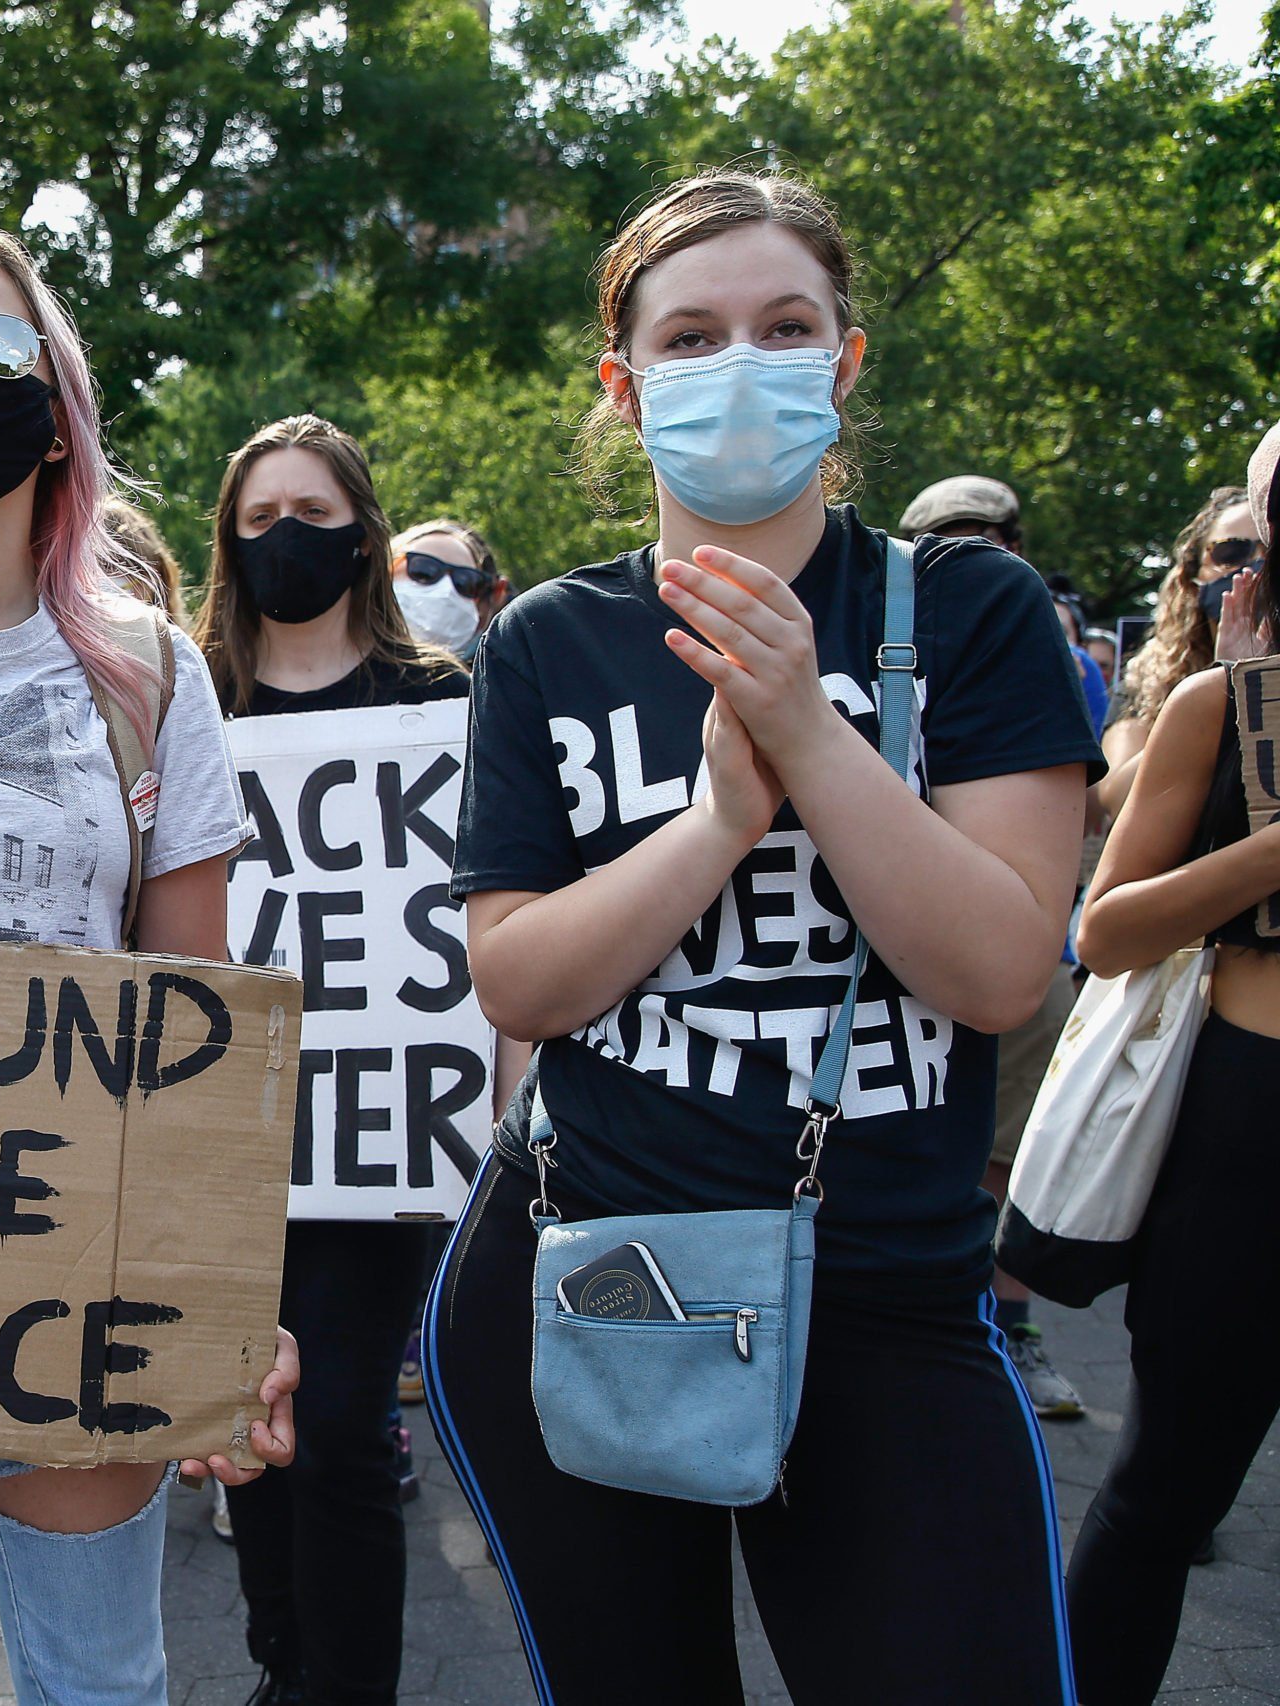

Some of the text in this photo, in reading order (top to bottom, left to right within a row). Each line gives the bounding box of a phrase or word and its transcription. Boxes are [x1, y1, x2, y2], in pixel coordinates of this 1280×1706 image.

[227, 751, 461, 882] ACK
[290, 1042, 487, 1188] TER
[588, 1282, 634, 1308] Culture
[596, 1292, 634, 1315] Street
